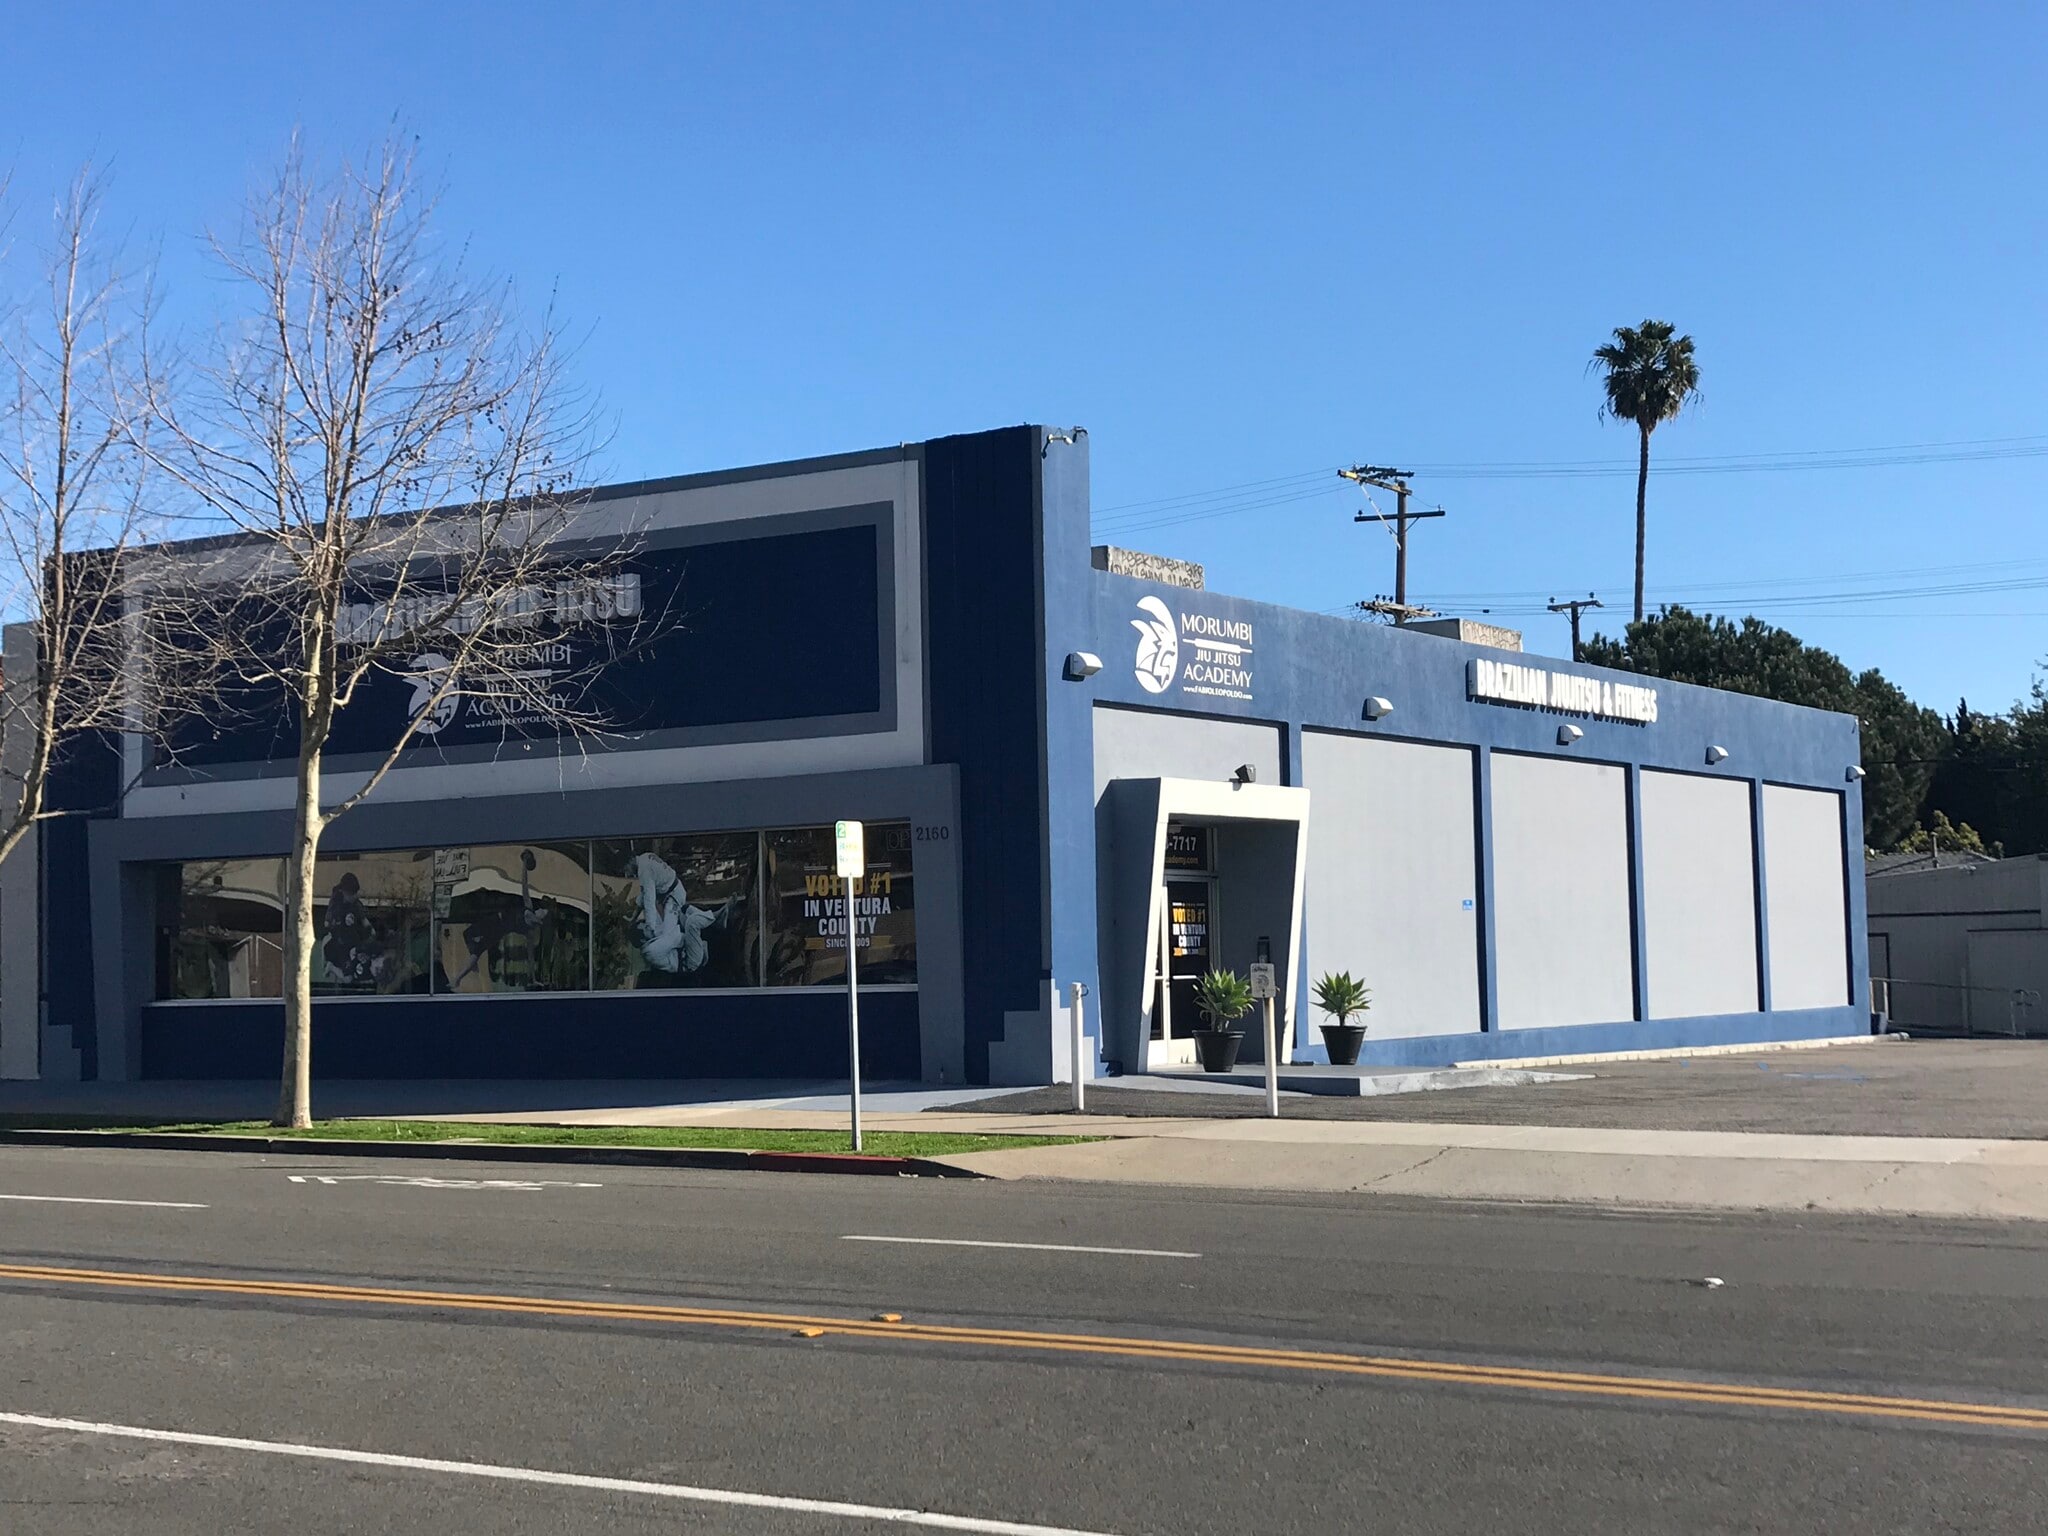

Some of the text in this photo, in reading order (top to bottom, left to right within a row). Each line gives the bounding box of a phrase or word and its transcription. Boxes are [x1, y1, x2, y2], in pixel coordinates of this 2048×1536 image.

[1181, 612, 1253, 645] MORUMBI
[1195, 649, 1241, 667] JIU JITSU
[1183, 662, 1253, 688] ACADEMY
[1476, 658, 1547, 706] BRAZILIAN
[1603, 680, 1614, 716] &
[1614, 682, 1658, 723] FITNESS
[916, 825, 949, 841] 2160
[870, 871, 892, 895] #1
[804, 896, 892, 917] IN VETURA
[854, 936, 871, 947] 009
